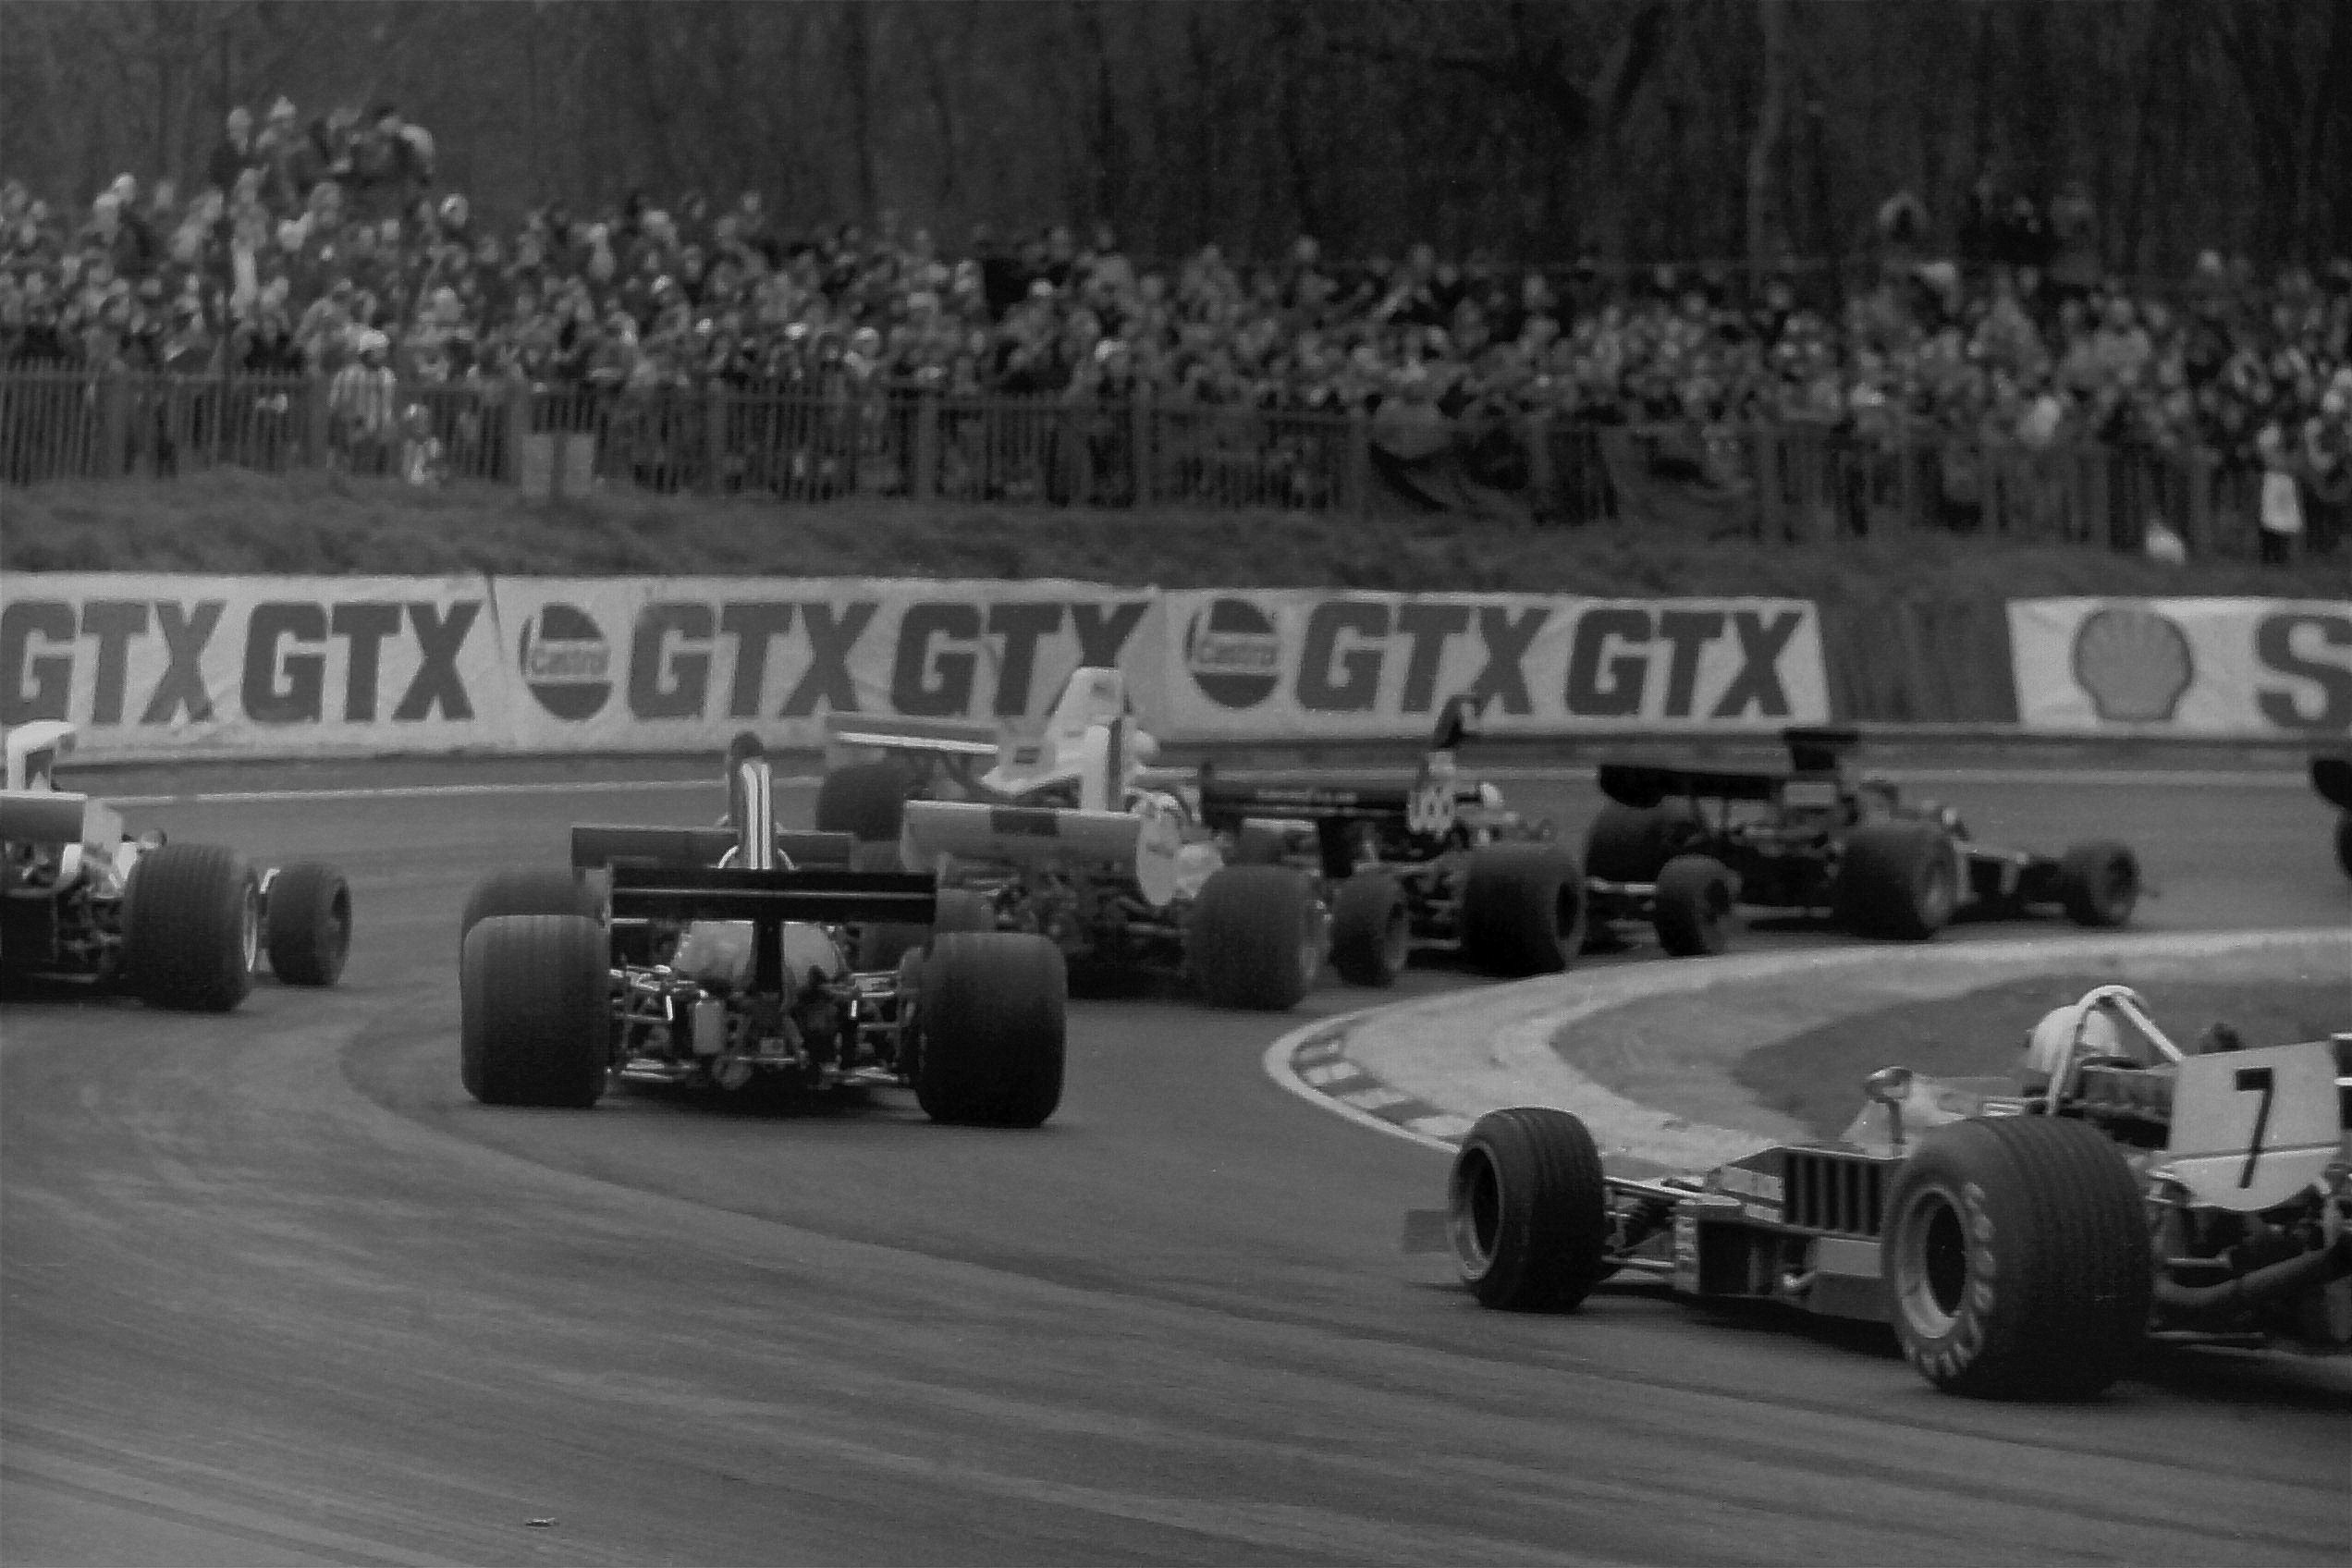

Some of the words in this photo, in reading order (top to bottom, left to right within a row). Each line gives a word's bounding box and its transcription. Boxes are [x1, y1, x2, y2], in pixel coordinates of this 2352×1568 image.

[0, 600, 227, 725] GTX
[242, 600, 484, 725] GTX
[629, 601, 880, 721] GTX
[1295, 600, 1551, 717] GTX
[1564, 607, 1804, 717] GTX
[2235, 1066, 2274, 1190] 7
